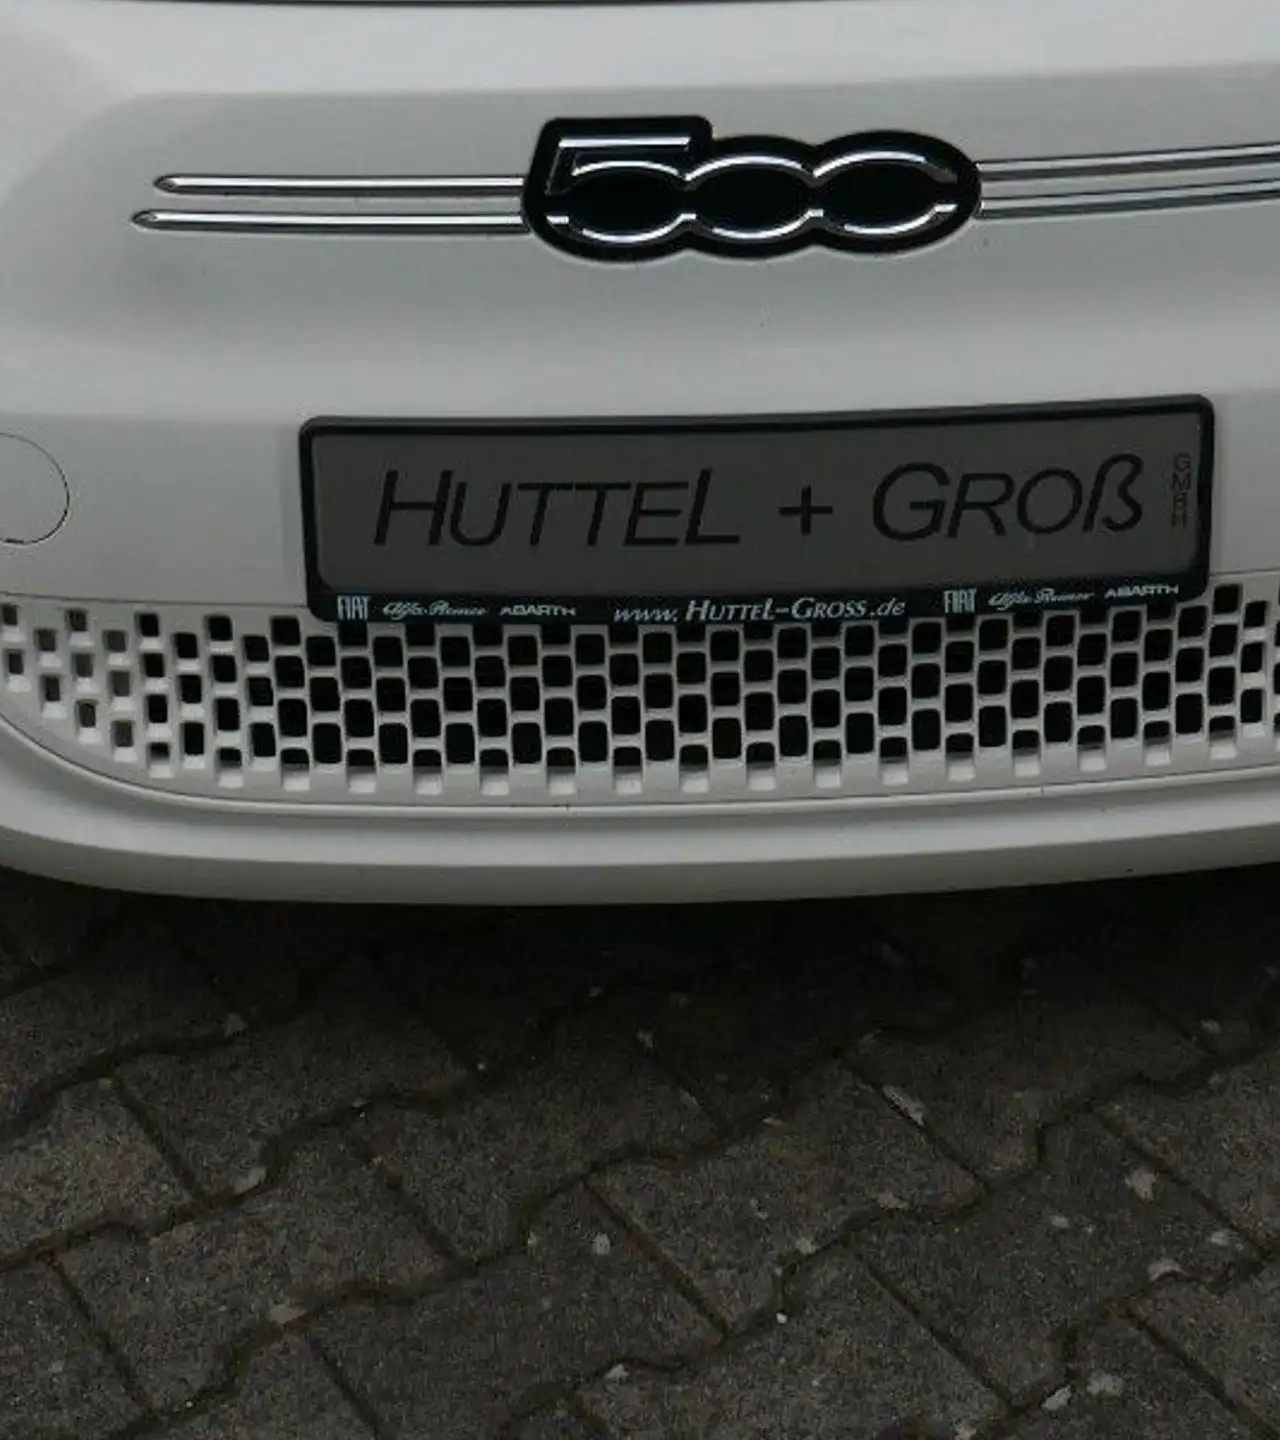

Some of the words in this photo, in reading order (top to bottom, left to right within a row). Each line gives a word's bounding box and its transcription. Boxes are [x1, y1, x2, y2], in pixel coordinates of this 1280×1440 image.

[523, 115, 982, 263] 500
[373, 467, 743, 547] HUTTEL
[778, 486, 834, 536] +
[336, 594, 371, 621] FIAT
[499, 603, 577, 617] ABARTH
[943, 588, 977, 614] FIAT
[1103, 583, 1181, 600] ABARTH
